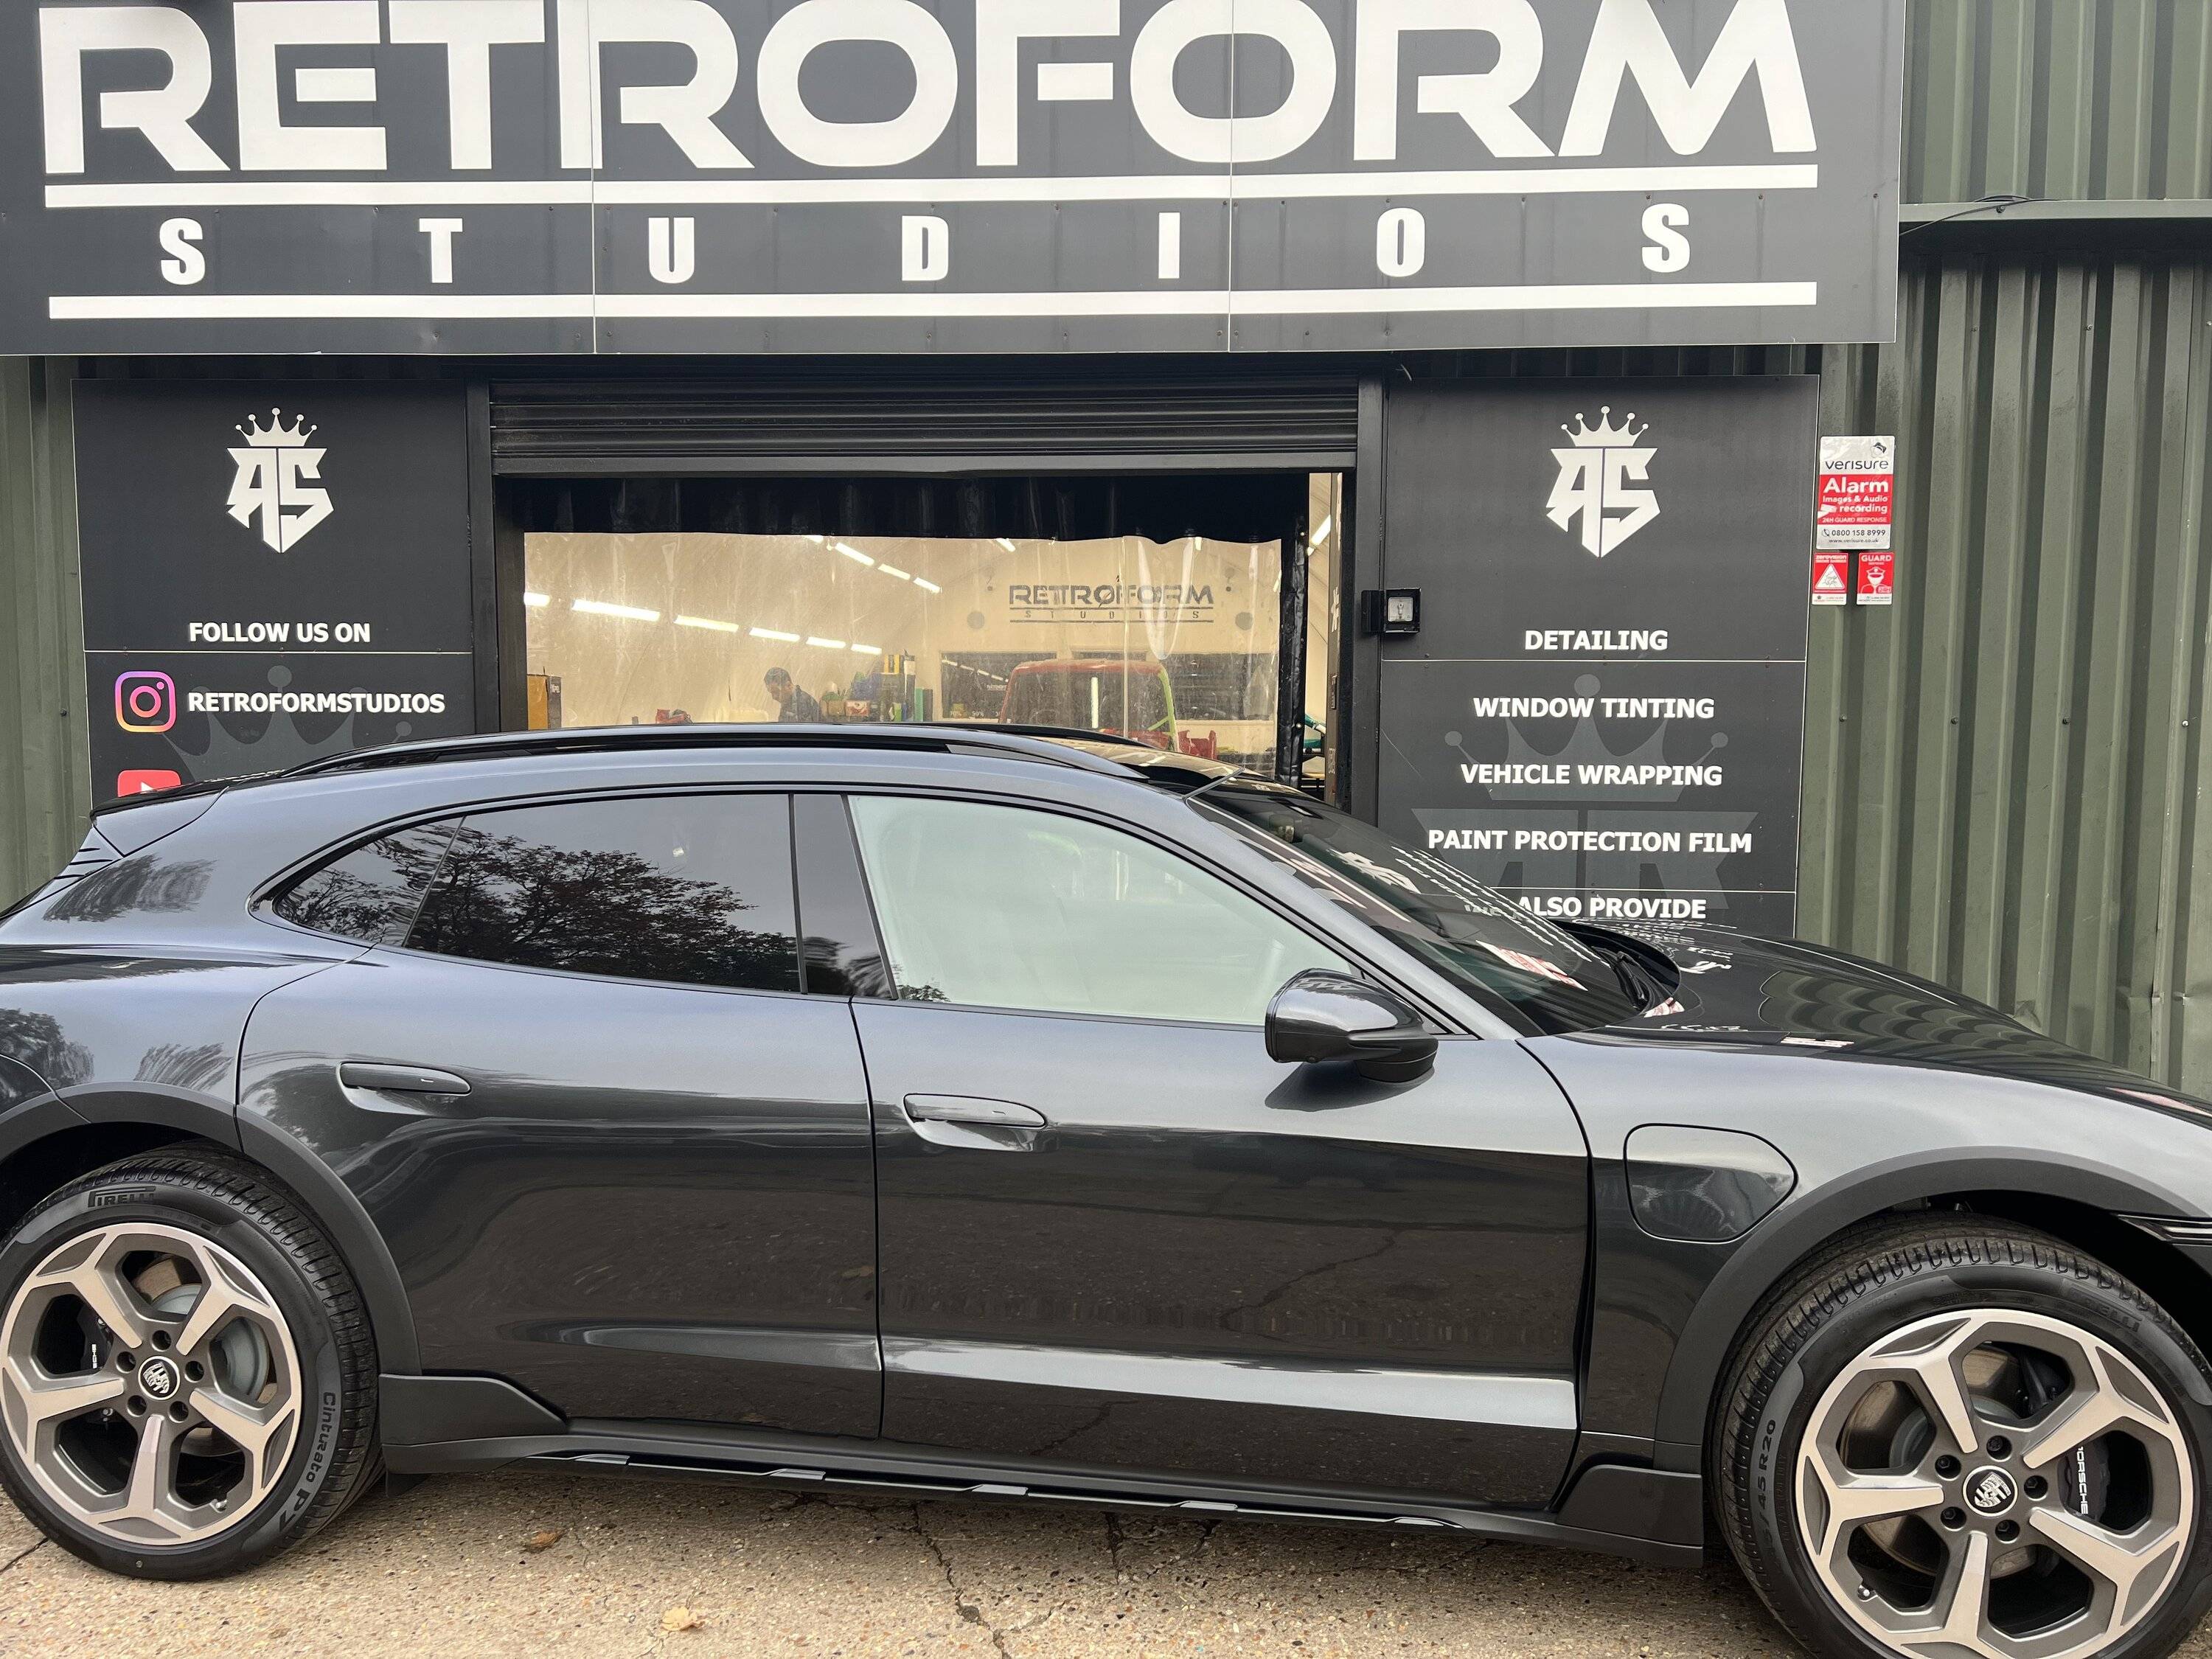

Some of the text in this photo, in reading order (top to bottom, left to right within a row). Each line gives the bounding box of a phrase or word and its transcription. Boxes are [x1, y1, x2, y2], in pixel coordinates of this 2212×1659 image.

[39, 0, 1817, 174] RETROFORM
[160, 202, 1691, 285] STUDIOS
[1825, 460, 1889, 470] verisure
[1823, 477, 1889, 493] Alarm
[1823, 495, 1852, 504] Images
[1839, 504, 1888, 514] recording
[189, 622, 371, 643] FOLLOW US ON
[1525, 630, 1669, 651] DETAILING
[188, 692, 445, 714] RETROFORMSTUDIOS
[1473, 698, 1714, 719] WINDOW TINTING
[1461, 764, 1722, 786] VEHICLE WRAPPING
[1428, 830, 1752, 853] PAINT PROTECTION FILM
[1590, 897, 1707, 919] PROVIDE
[88, 1186, 156, 1207] PIRELLI
[305, 1392, 336, 1483] Cinturato
[1759, 1419, 1776, 1471] R20
